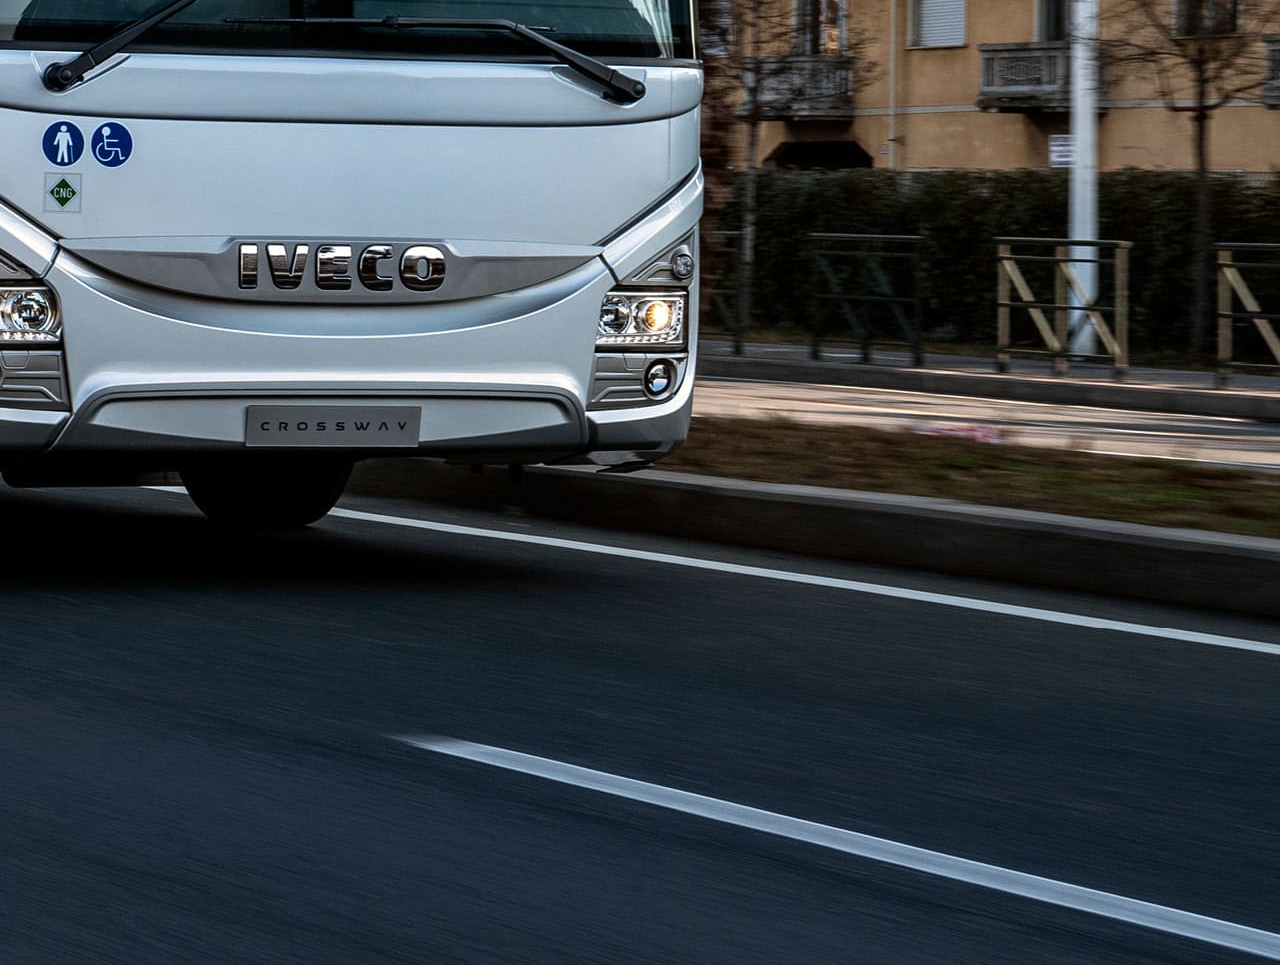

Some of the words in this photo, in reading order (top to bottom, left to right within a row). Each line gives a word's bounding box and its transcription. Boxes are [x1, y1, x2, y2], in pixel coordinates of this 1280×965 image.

[53, 187, 73, 199] CNG
[237, 243, 447, 291] IVECO
[260, 421, 408, 432] CROSSWAY
